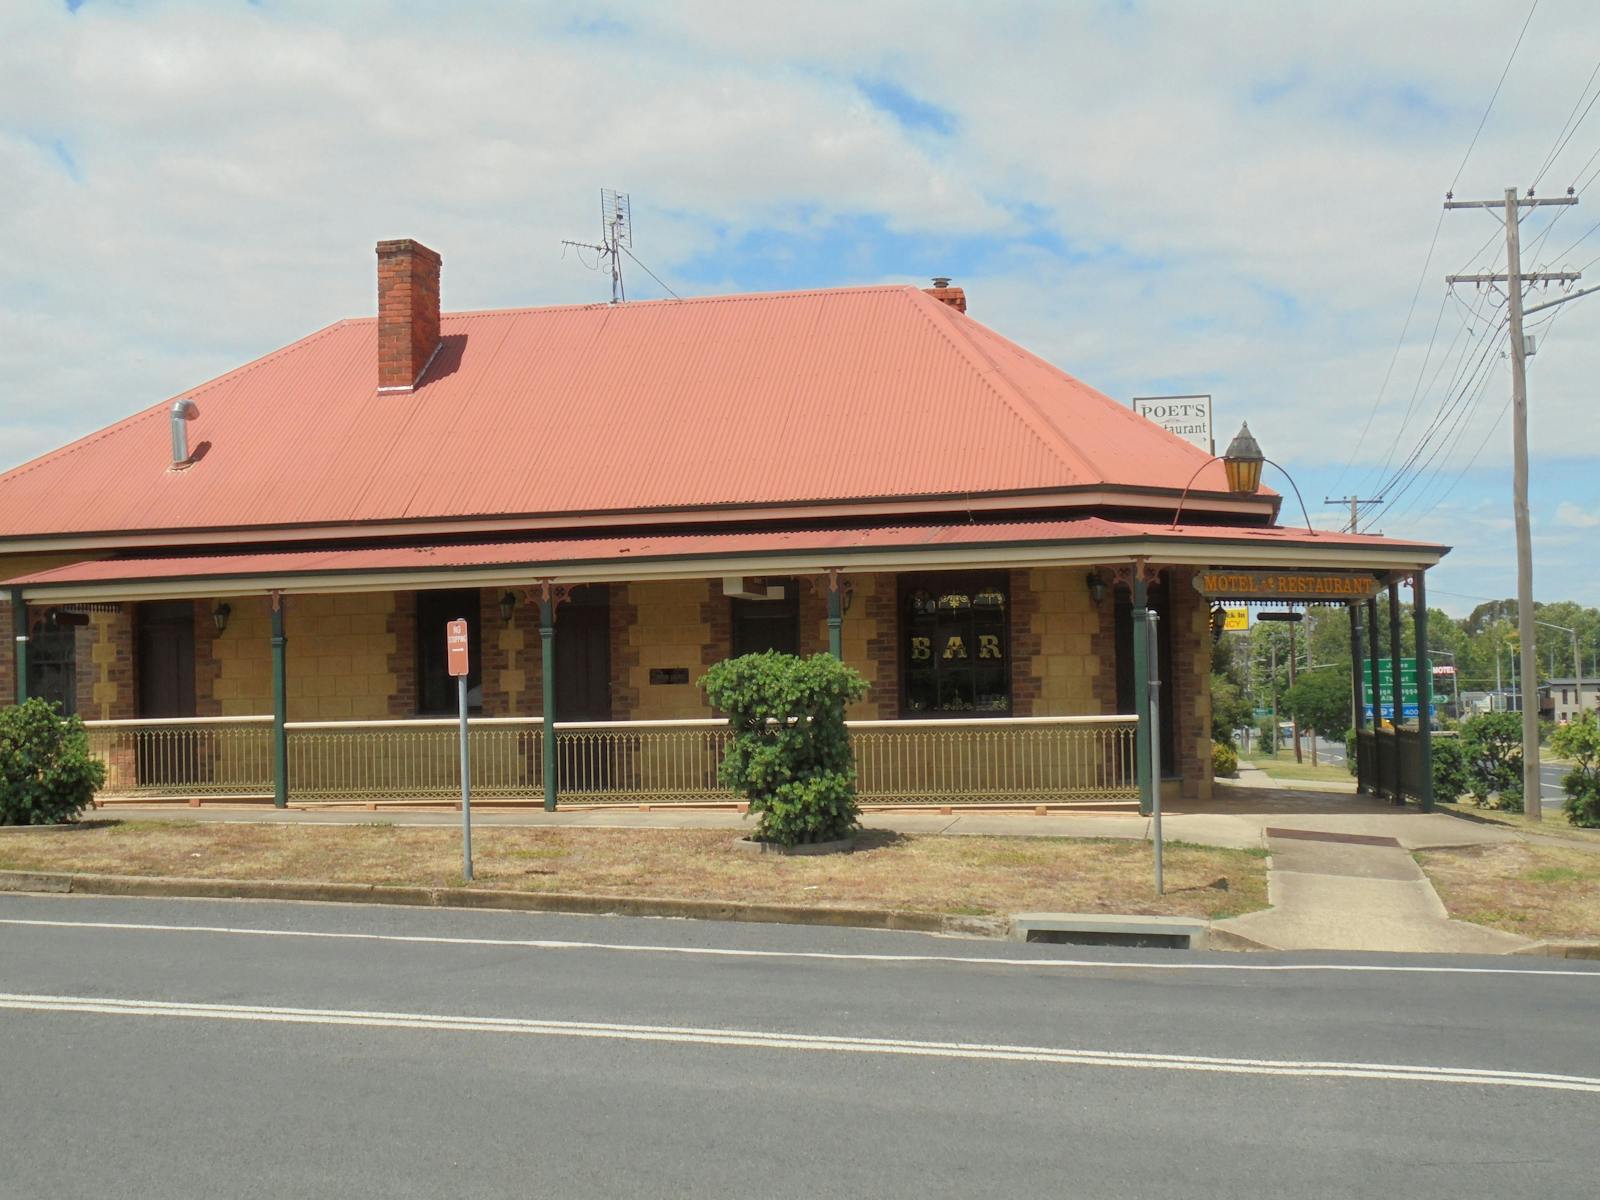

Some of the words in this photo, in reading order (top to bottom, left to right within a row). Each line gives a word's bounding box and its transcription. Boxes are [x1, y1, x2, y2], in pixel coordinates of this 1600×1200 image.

[1141, 404, 1206, 418] POET'S
[1164, 422, 1207, 435] taurant
[1203, 575, 1258, 592] MOTEL
[1278, 576, 1373, 593] RESTAURANT
[453, 625, 462, 634] NO
[911, 634, 1002, 660] BAR
[1432, 666, 1455, 674] MOTEL
